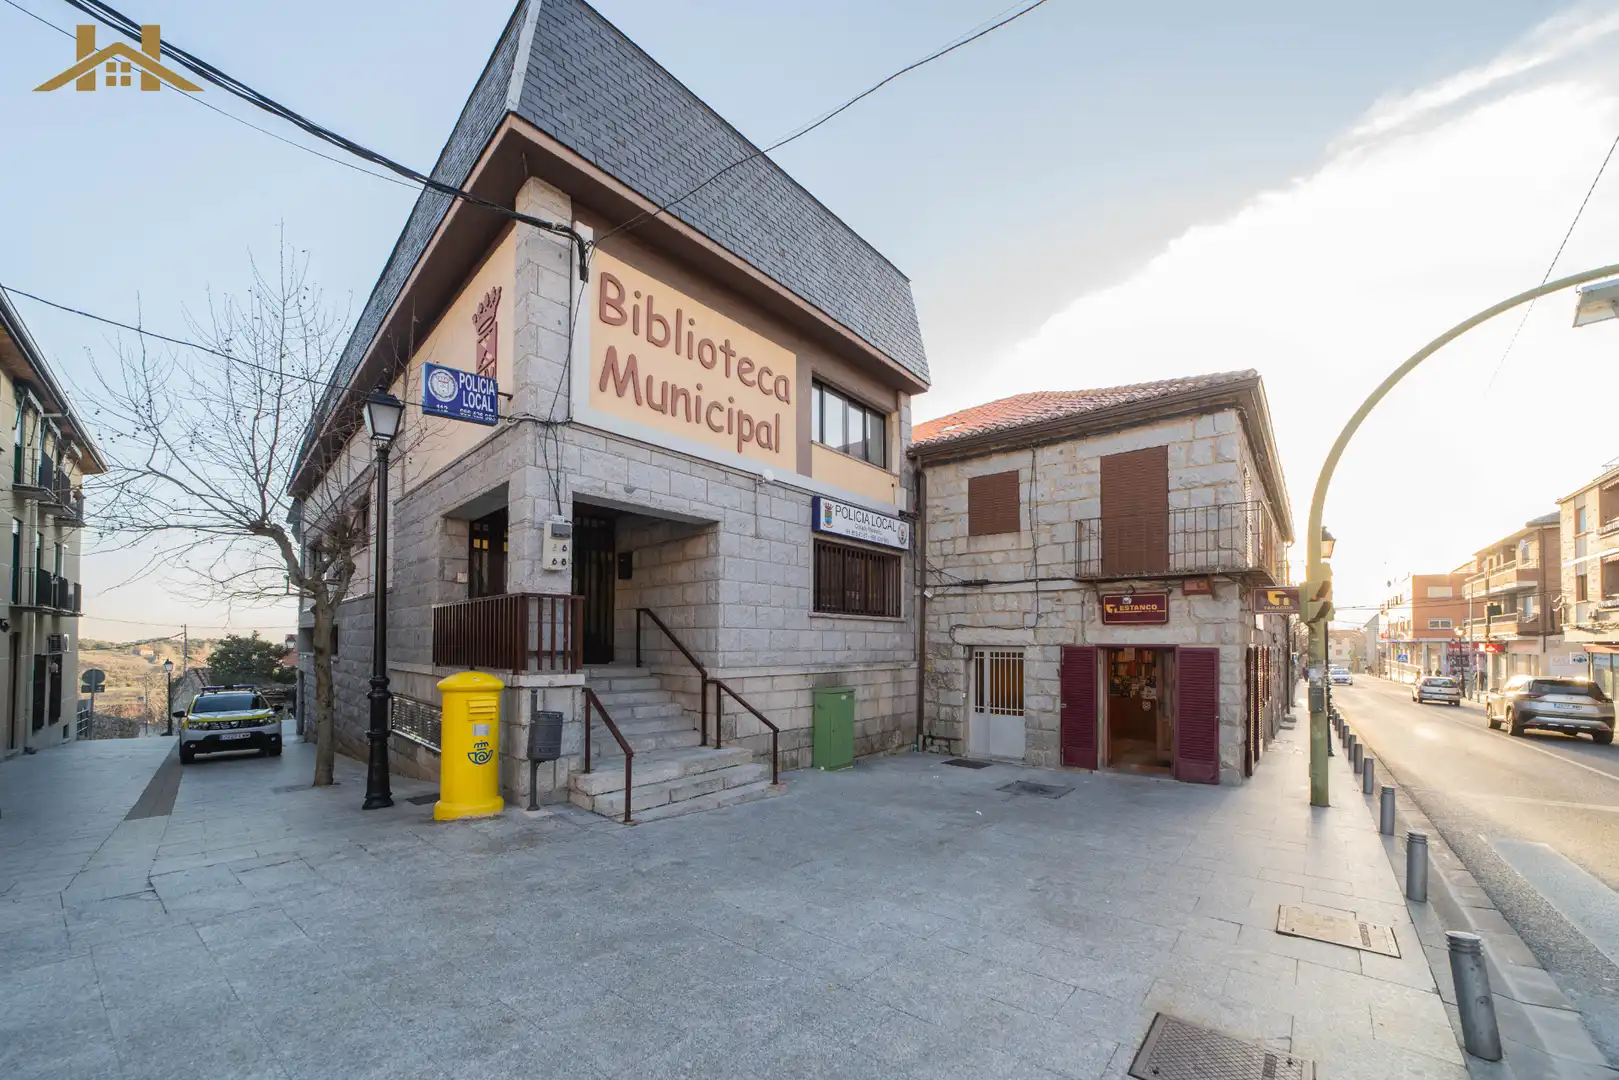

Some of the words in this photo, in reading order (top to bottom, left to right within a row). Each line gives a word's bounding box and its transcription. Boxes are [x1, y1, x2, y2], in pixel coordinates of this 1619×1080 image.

[599, 271, 791, 405] Biblioteca
[459, 372, 495, 396] POLICIA
[462, 390, 494, 413] LOCAL
[599, 345, 780, 454] Municipal
[835, 504, 870, 525] POLICIA
[871, 515, 897, 532] LOCAL
